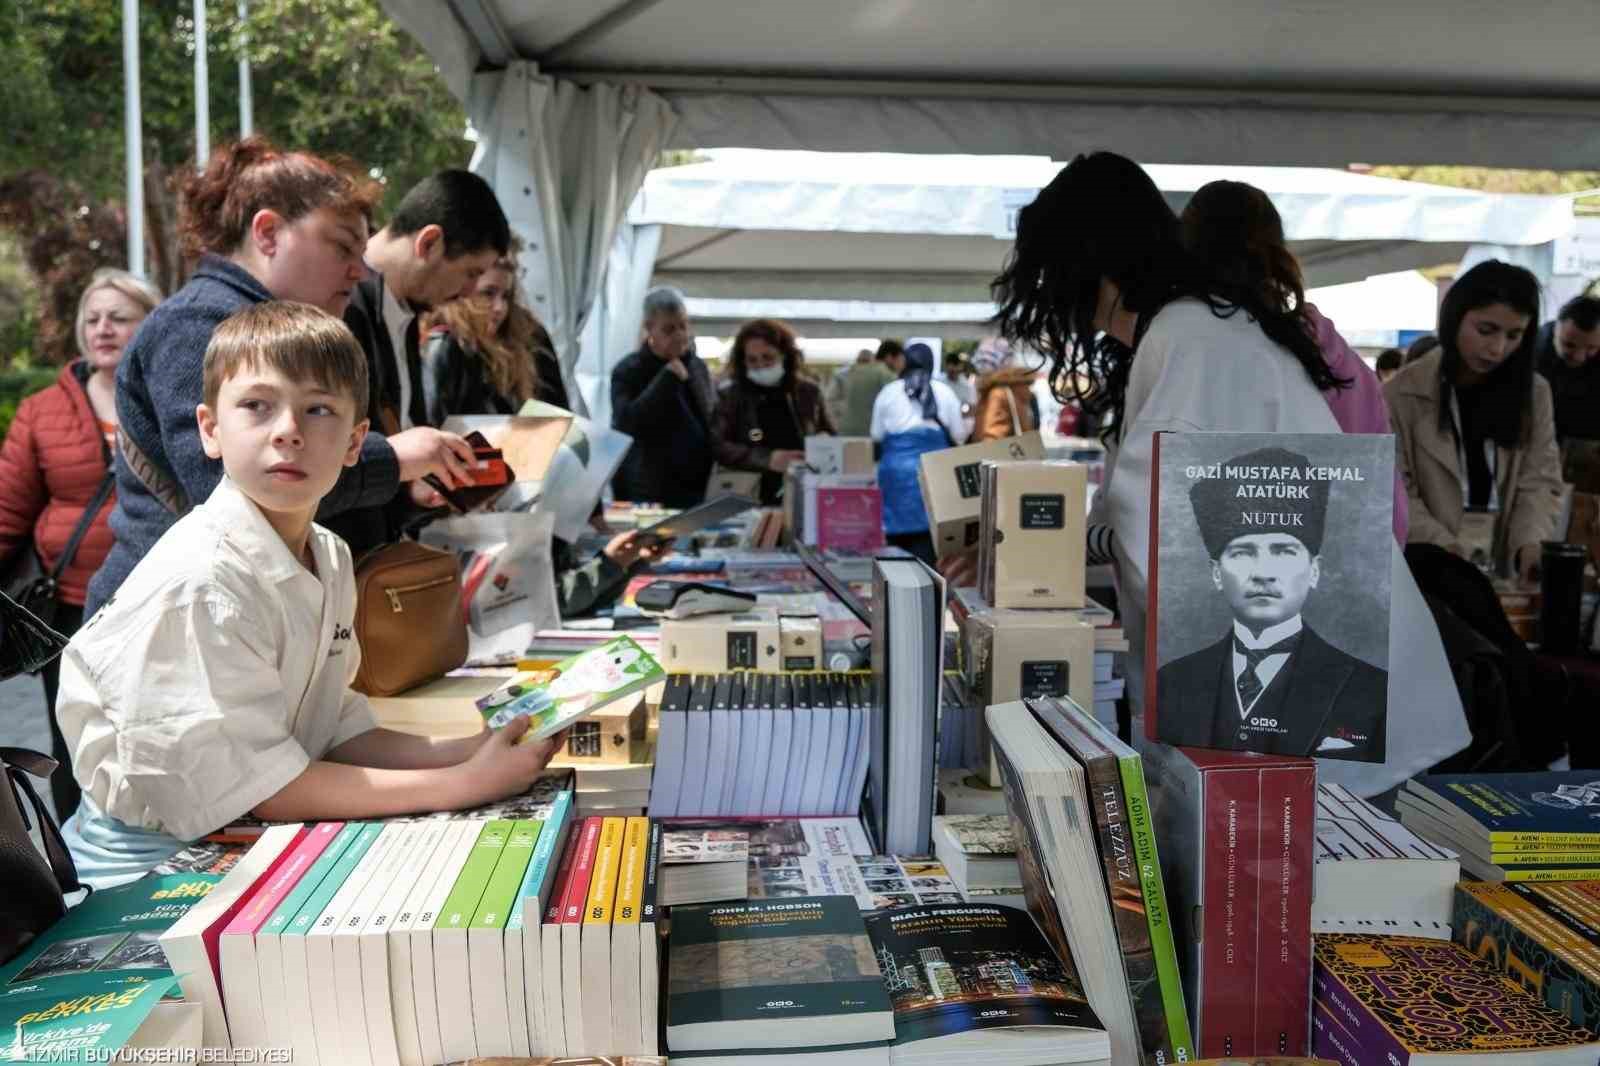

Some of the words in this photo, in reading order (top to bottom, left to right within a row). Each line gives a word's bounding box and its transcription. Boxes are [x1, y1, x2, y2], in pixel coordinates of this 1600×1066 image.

[1186, 463, 1221, 479] GAZİ
[1225, 466, 1302, 481] MUSTAFA
[1305, 466, 1365, 482] KEMAL
[1236, 482, 1310, 500] ATATÜRK
[1241, 511, 1305, 527] NUTUK
[1129, 797, 1143, 827] ADIM
[1102, 786, 1131, 880] TELEZZÜZ
[1136, 831, 1151, 861] ADIM
[1143, 864, 1153, 879] 62
[708, 906, 745, 915] JOHN
[766, 902, 822, 911] HOBSON
[1146, 880, 1162, 928] SALATA
[890, 911, 931, 922] NIALL
[931, 908, 1001, 916] FERGUSON
[16, 997, 132, 1025] BERKES
